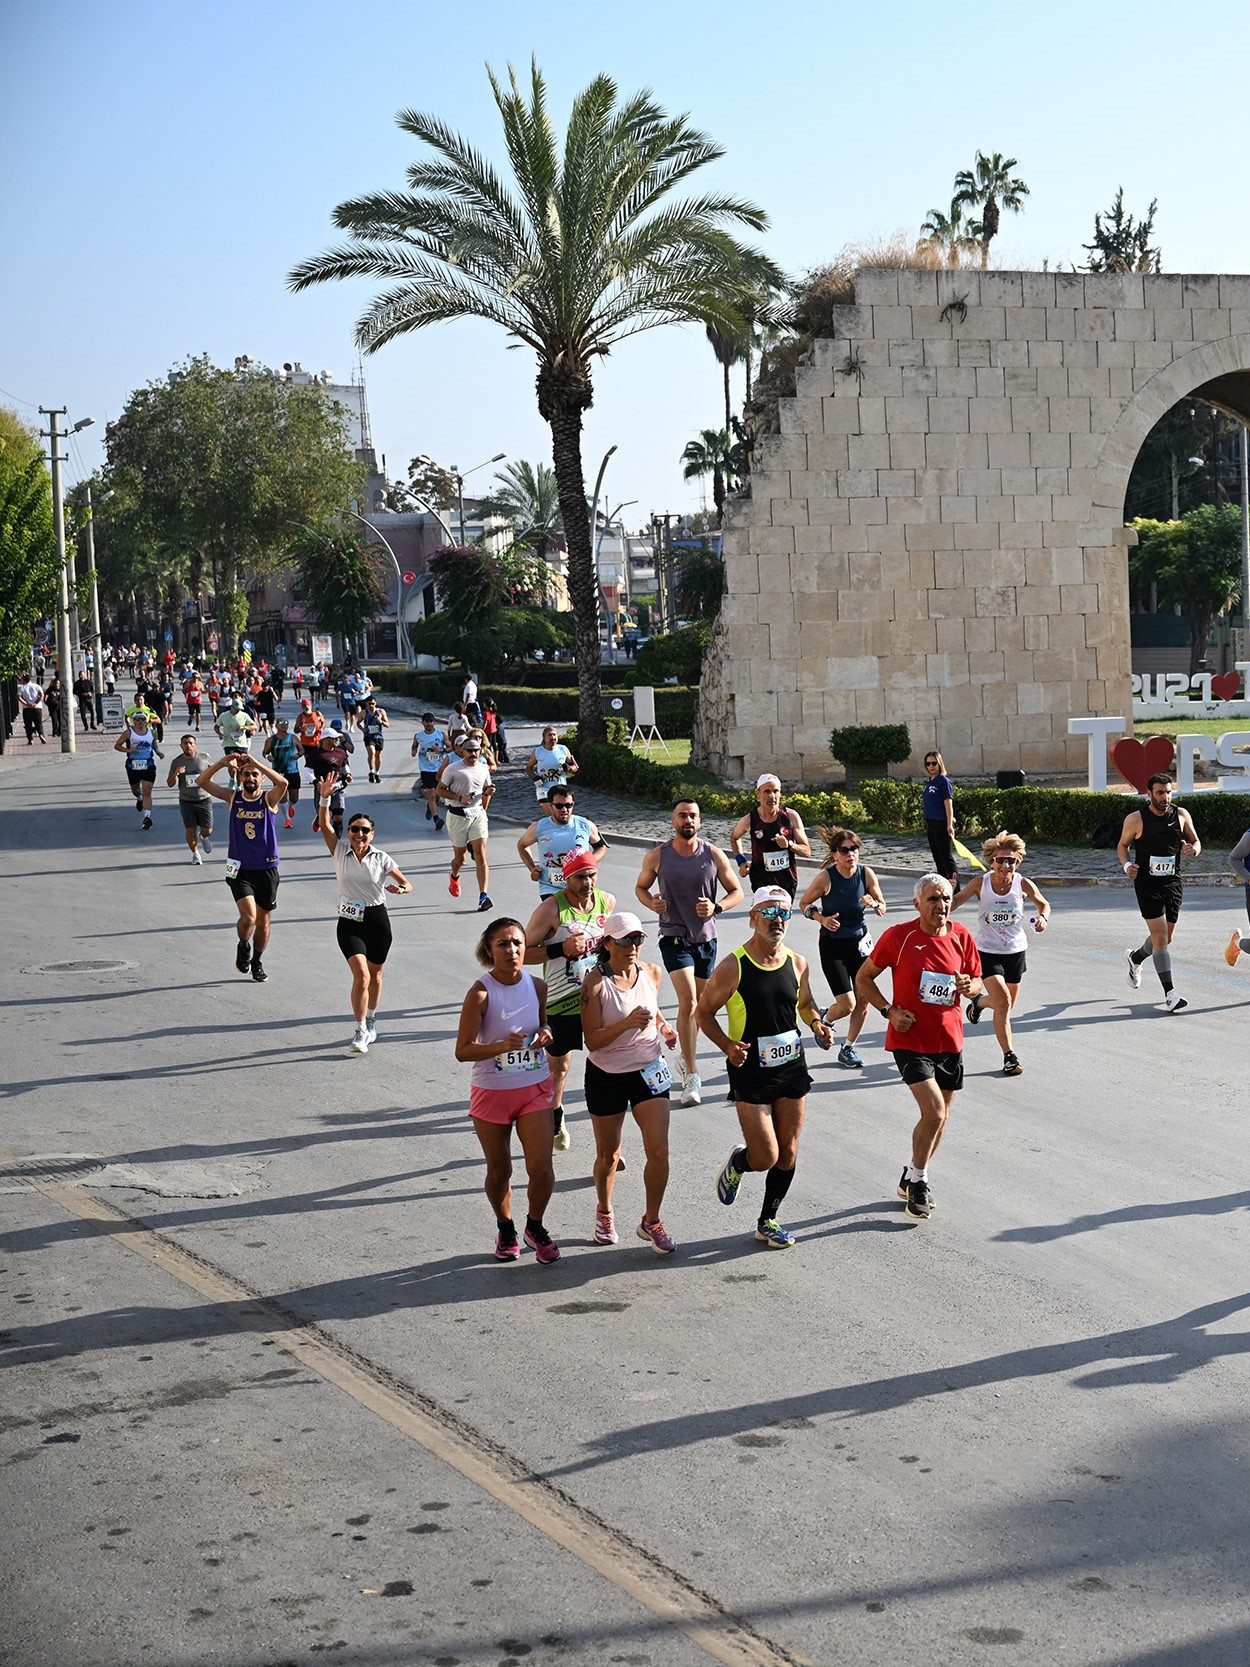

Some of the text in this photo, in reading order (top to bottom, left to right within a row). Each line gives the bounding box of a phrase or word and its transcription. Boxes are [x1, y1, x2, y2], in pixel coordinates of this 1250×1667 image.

[245, 822, 256, 840] 6
[770, 858, 785, 866] 416
[341, 905, 356, 915] 248
[993, 914, 1008, 922] 380
[929, 985, 949, 997] 484
[507, 1051, 530, 1065] 514
[771, 1045, 792, 1059] 309
[655, 1067, 670, 1084] 219
